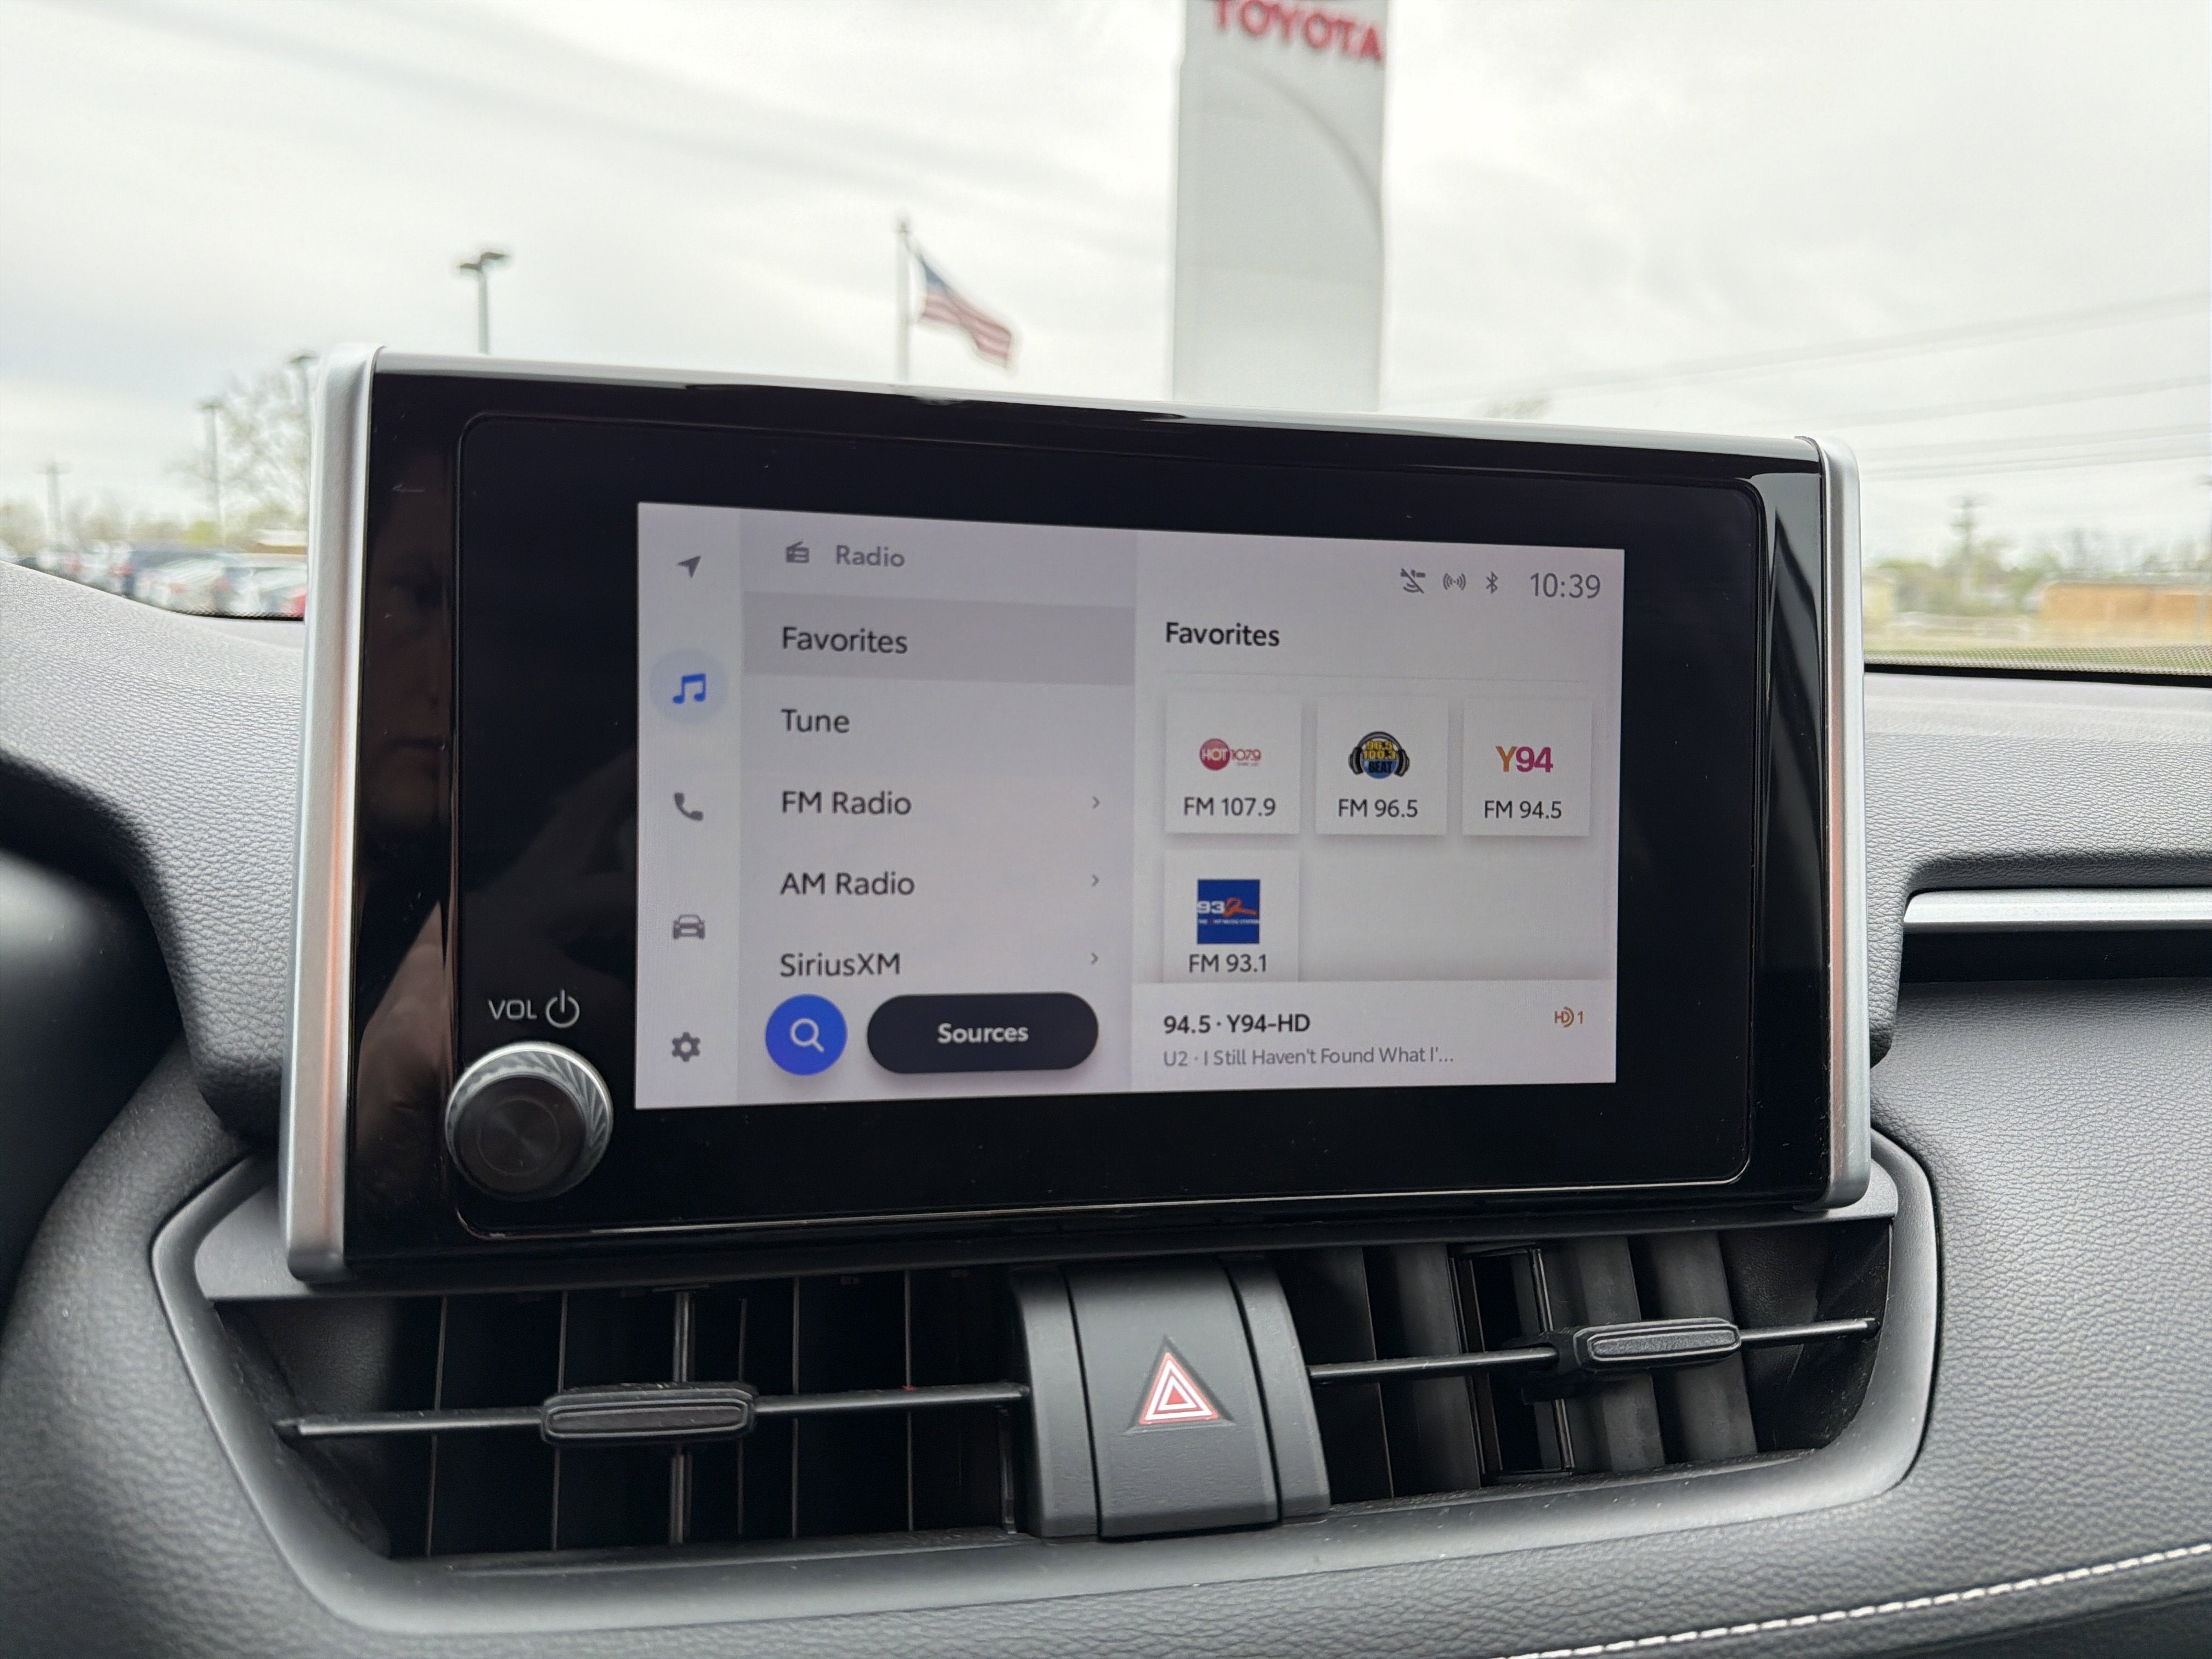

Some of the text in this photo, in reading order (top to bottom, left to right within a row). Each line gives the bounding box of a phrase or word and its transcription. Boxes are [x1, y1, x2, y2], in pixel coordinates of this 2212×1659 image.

[1215, 0, 1382, 61] TOYOTA
[836, 545, 906, 567] Radio
[1530, 573, 1601, 599] 10:39
[782, 627, 908, 654] Favorites
[1165, 622, 1280, 647] Favorites
[781, 709, 850, 733] Tune
[1201, 748, 1229, 761] HOT
[1496, 746, 1554, 772] Y94
[782, 791, 912, 816] FM Radio
[1183, 798, 1276, 817] FM 107.9
[1338, 799, 1418, 818] FM 96.5
[1484, 800, 1562, 819] FM 94.5
[780, 871, 915, 896] AM Radio
[780, 952, 901, 977] SiriusXM
[1188, 954, 1267, 973] FM 93.1
[488, 1000, 538, 1021] VOL
[937, 1023, 1029, 1044] Sources
[1163, 1013, 1311, 1034] 94.5 Y94-HD
[1163, 1050, 1188, 1066] U2
[1203, 1050, 1209, 1065] I
[1213, 1048, 1246, 1065] Still
[1251, 1048, 1317, 1065] Haven't
[1320, 1047, 1374, 1064] Found
[1378, 1046, 1426, 1063] What
